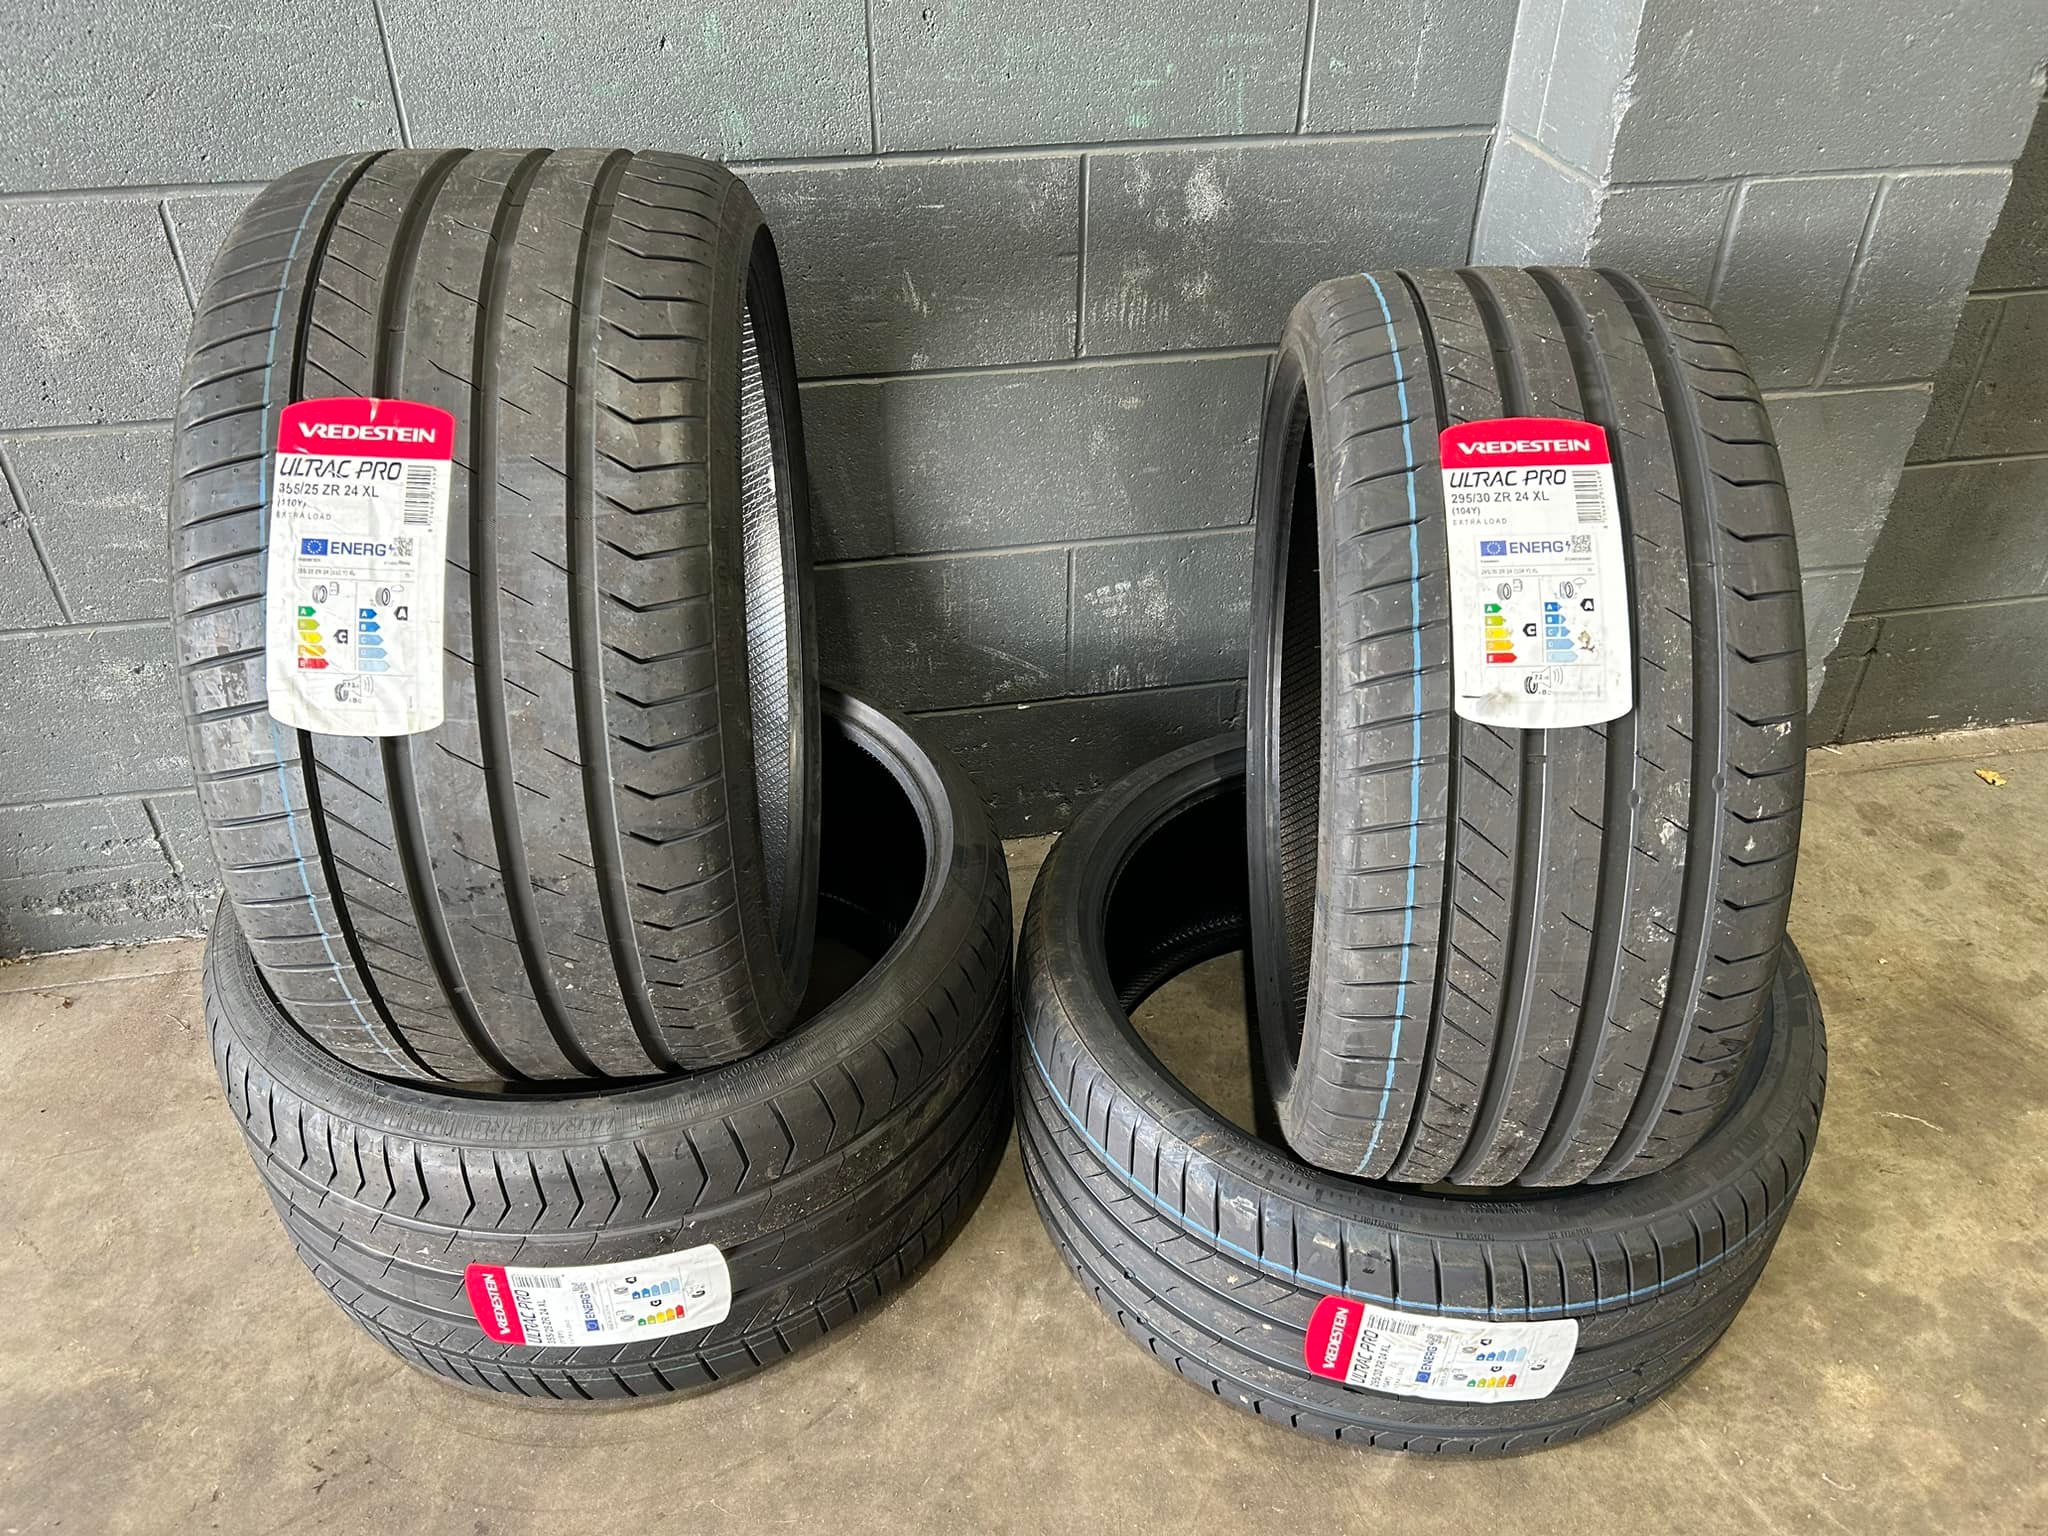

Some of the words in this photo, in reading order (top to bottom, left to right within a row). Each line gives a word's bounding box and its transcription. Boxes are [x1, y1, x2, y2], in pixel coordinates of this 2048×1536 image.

[298, 422, 436, 443] VREDESTEIN
[1457, 439, 1591, 455] VREDESTEIN
[280, 457, 352, 479] ULTRAC
[355, 461, 402, 481] PRO
[1450, 470, 1518, 488] ULTRAC
[1523, 469, 1567, 486] PRO
[279, 481, 319, 496] 355/25
[322, 483, 341, 496] ZR
[343, 484, 359, 497] 24
[362, 485, 379, 498] XL
[1451, 493, 1491, 504] 295/30
[1494, 491, 1512, 503] ZR
[1515, 491, 1529, 502] 24
[1533, 490, 1550, 501] XL
[307, 512, 332, 521] LOAD
[1451, 506, 1481, 517] (104Y)
[1484, 517, 1508, 526] LOAD
[330, 541, 387, 557] ENERG
[1509, 540, 1564, 554] ENERG
[482, 1273, 511, 1336] VREDESTEIN
[514, 1289, 535, 1311] PRO
[580, 1293, 596, 1319] ENERG
[520, 1311, 543, 1344] ULTRAC
[1322, 1306, 1350, 1369] VREDESTEIN
[1360, 1329, 1379, 1353] PRO
[1420, 1343, 1438, 1371] ENERG
[1351, 1352, 1372, 1384] ULTRAC
